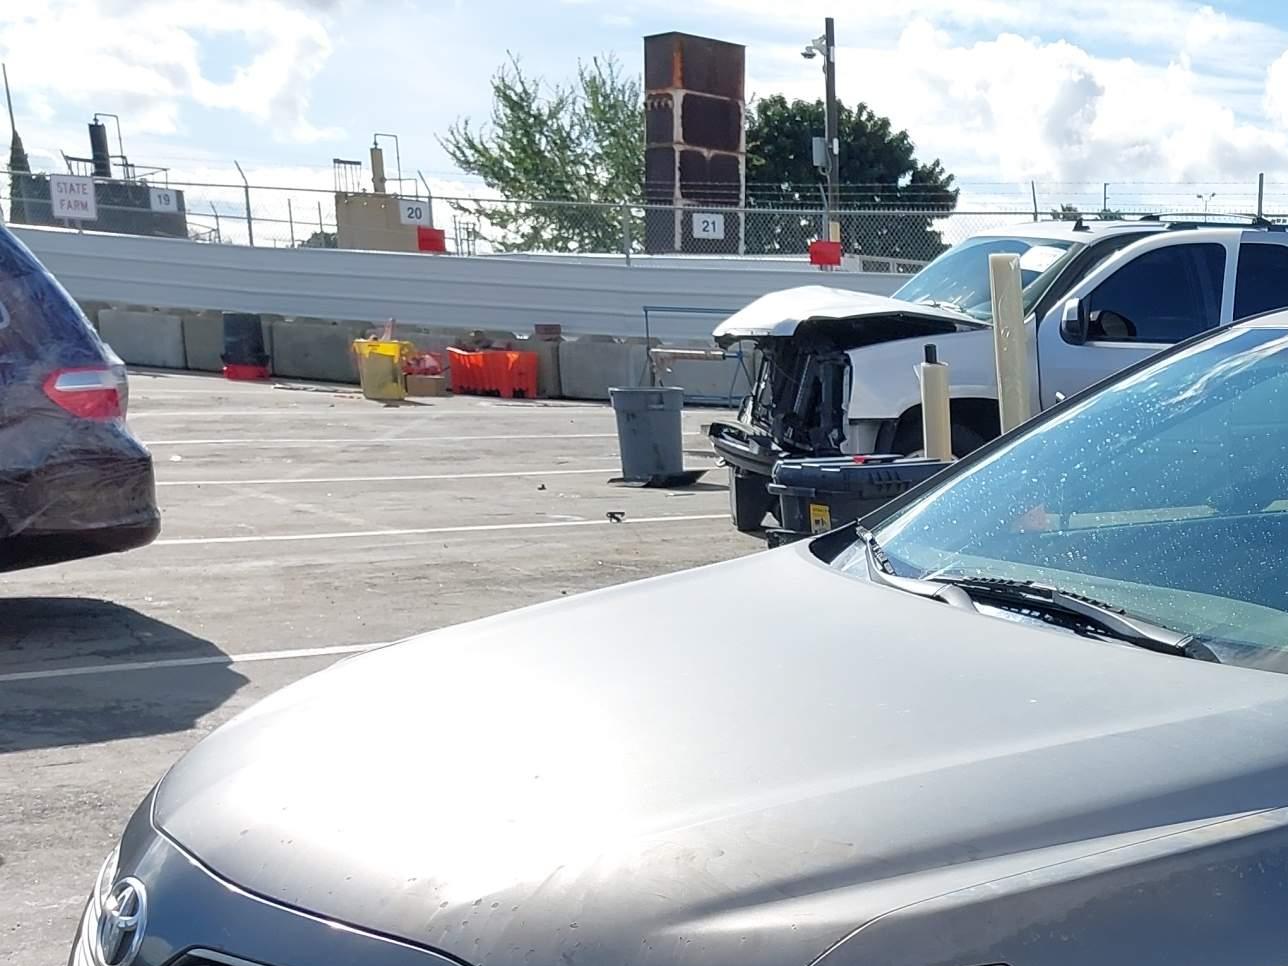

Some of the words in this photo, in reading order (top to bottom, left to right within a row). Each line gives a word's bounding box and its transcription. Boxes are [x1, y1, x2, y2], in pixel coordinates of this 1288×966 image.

[56, 182, 89, 195] STATE
[59, 199, 89, 211] FARM
[157, 193, 171, 206] 19
[407, 206, 423, 220] 20
[702, 219, 716, 233] 21
